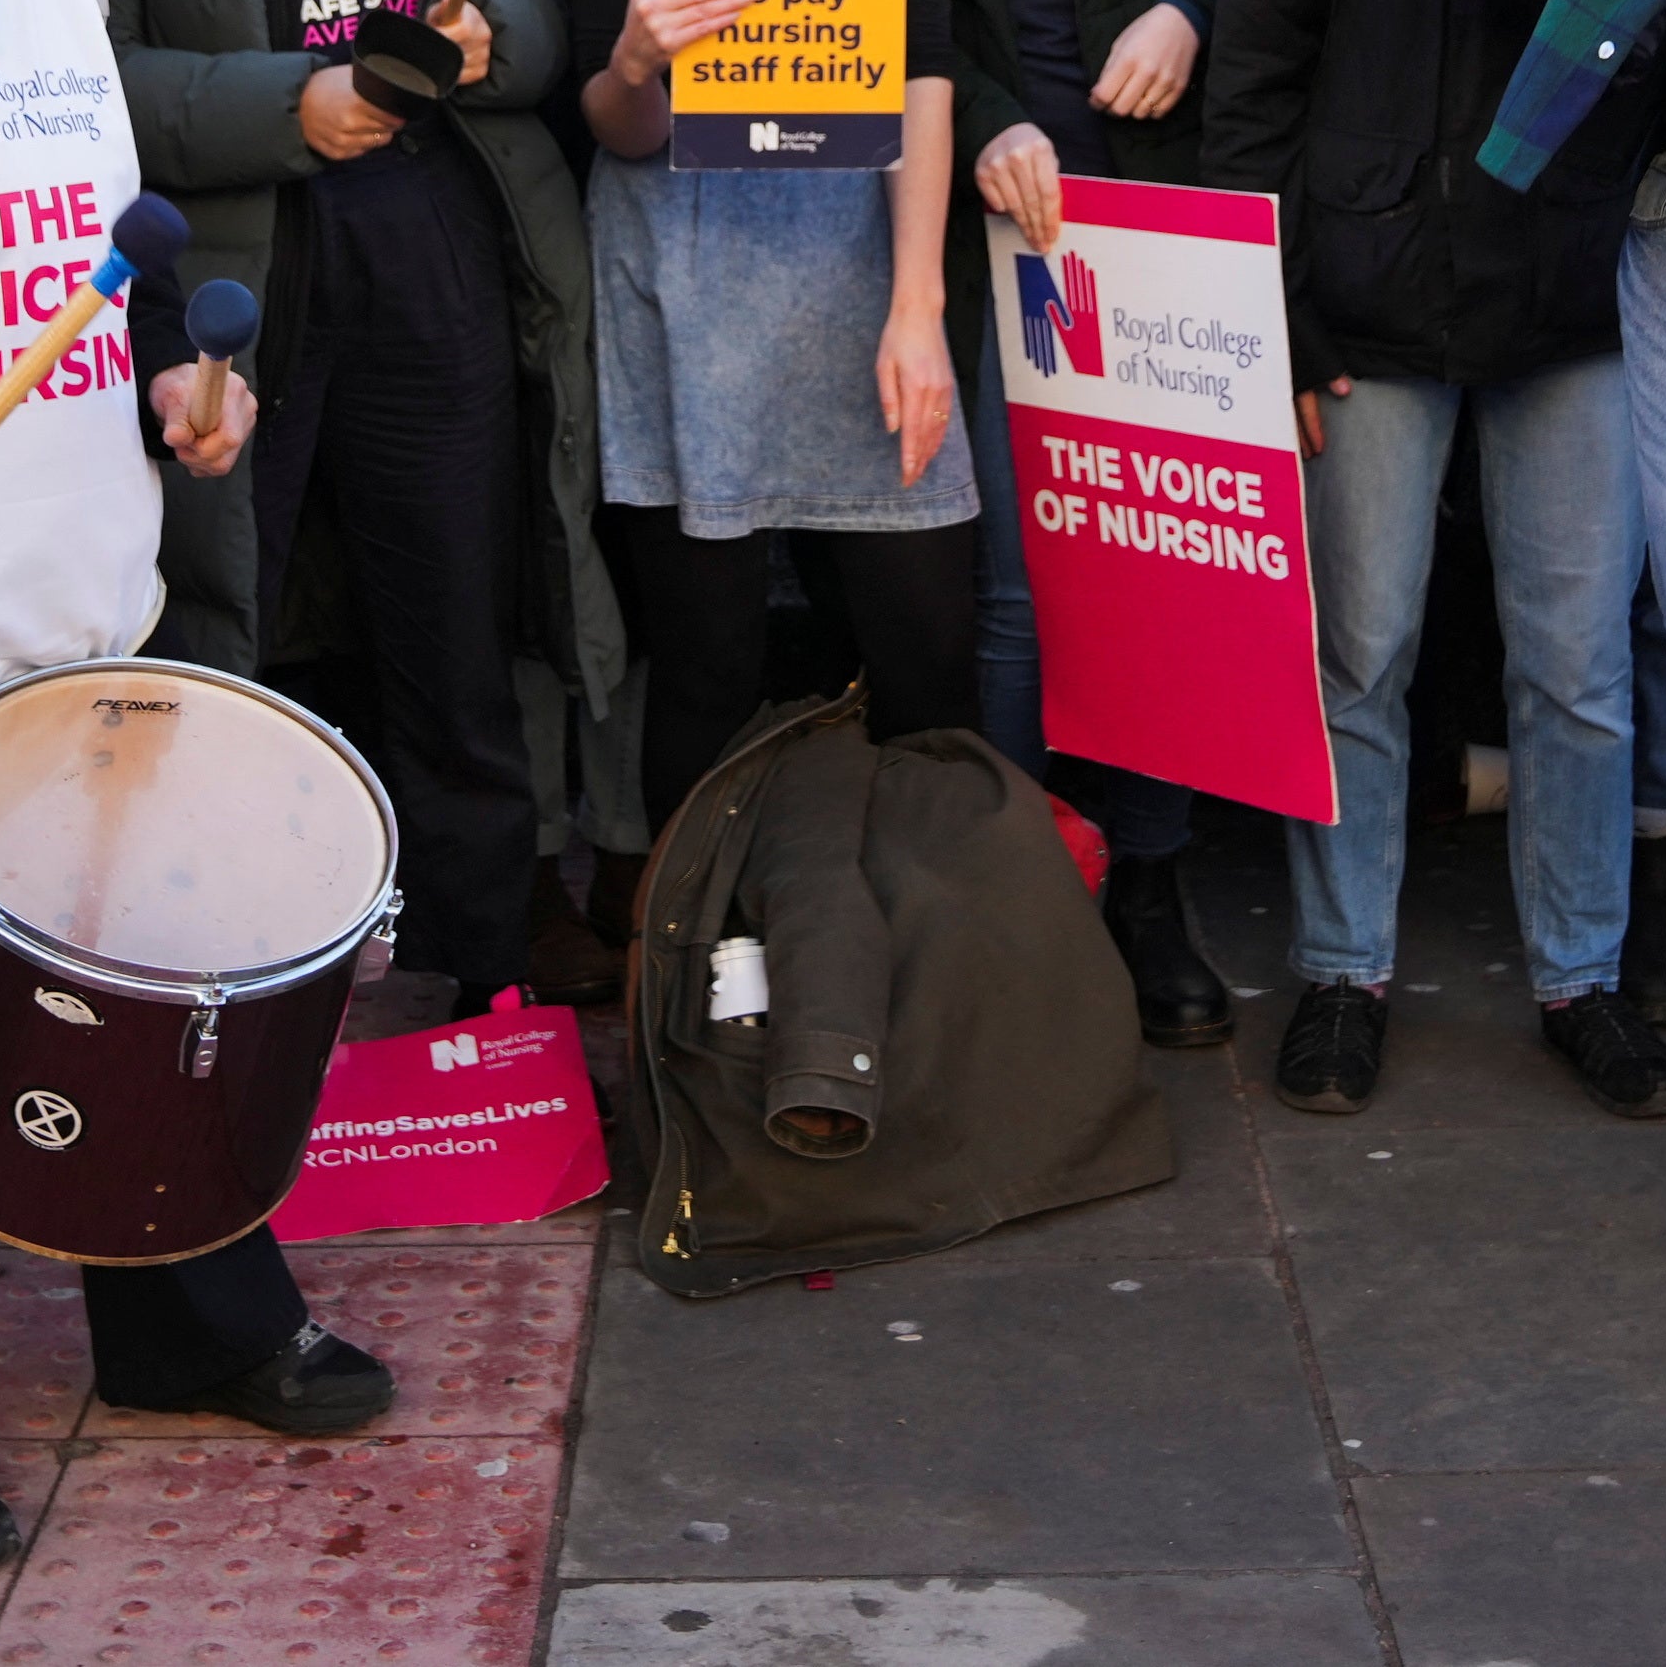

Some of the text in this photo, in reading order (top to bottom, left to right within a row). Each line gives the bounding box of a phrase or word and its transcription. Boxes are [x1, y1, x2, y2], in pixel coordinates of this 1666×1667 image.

[303, 16, 359, 49] AVE
[717, 15, 862, 50] nursing
[47, 68, 110, 107] College
[693, 55, 886, 89] staff fairly
[3, 109, 102, 141] of Nursing
[1113, 308, 1262, 369] Royal College
[1117, 353, 1233, 411] of Nursing
[1042, 435, 1265, 518] THE VOICE
[1034, 489, 1290, 580] OF NURSING
[481, 1030, 557, 1050] Royal College
[482, 1043, 544, 1061] of Nursing
